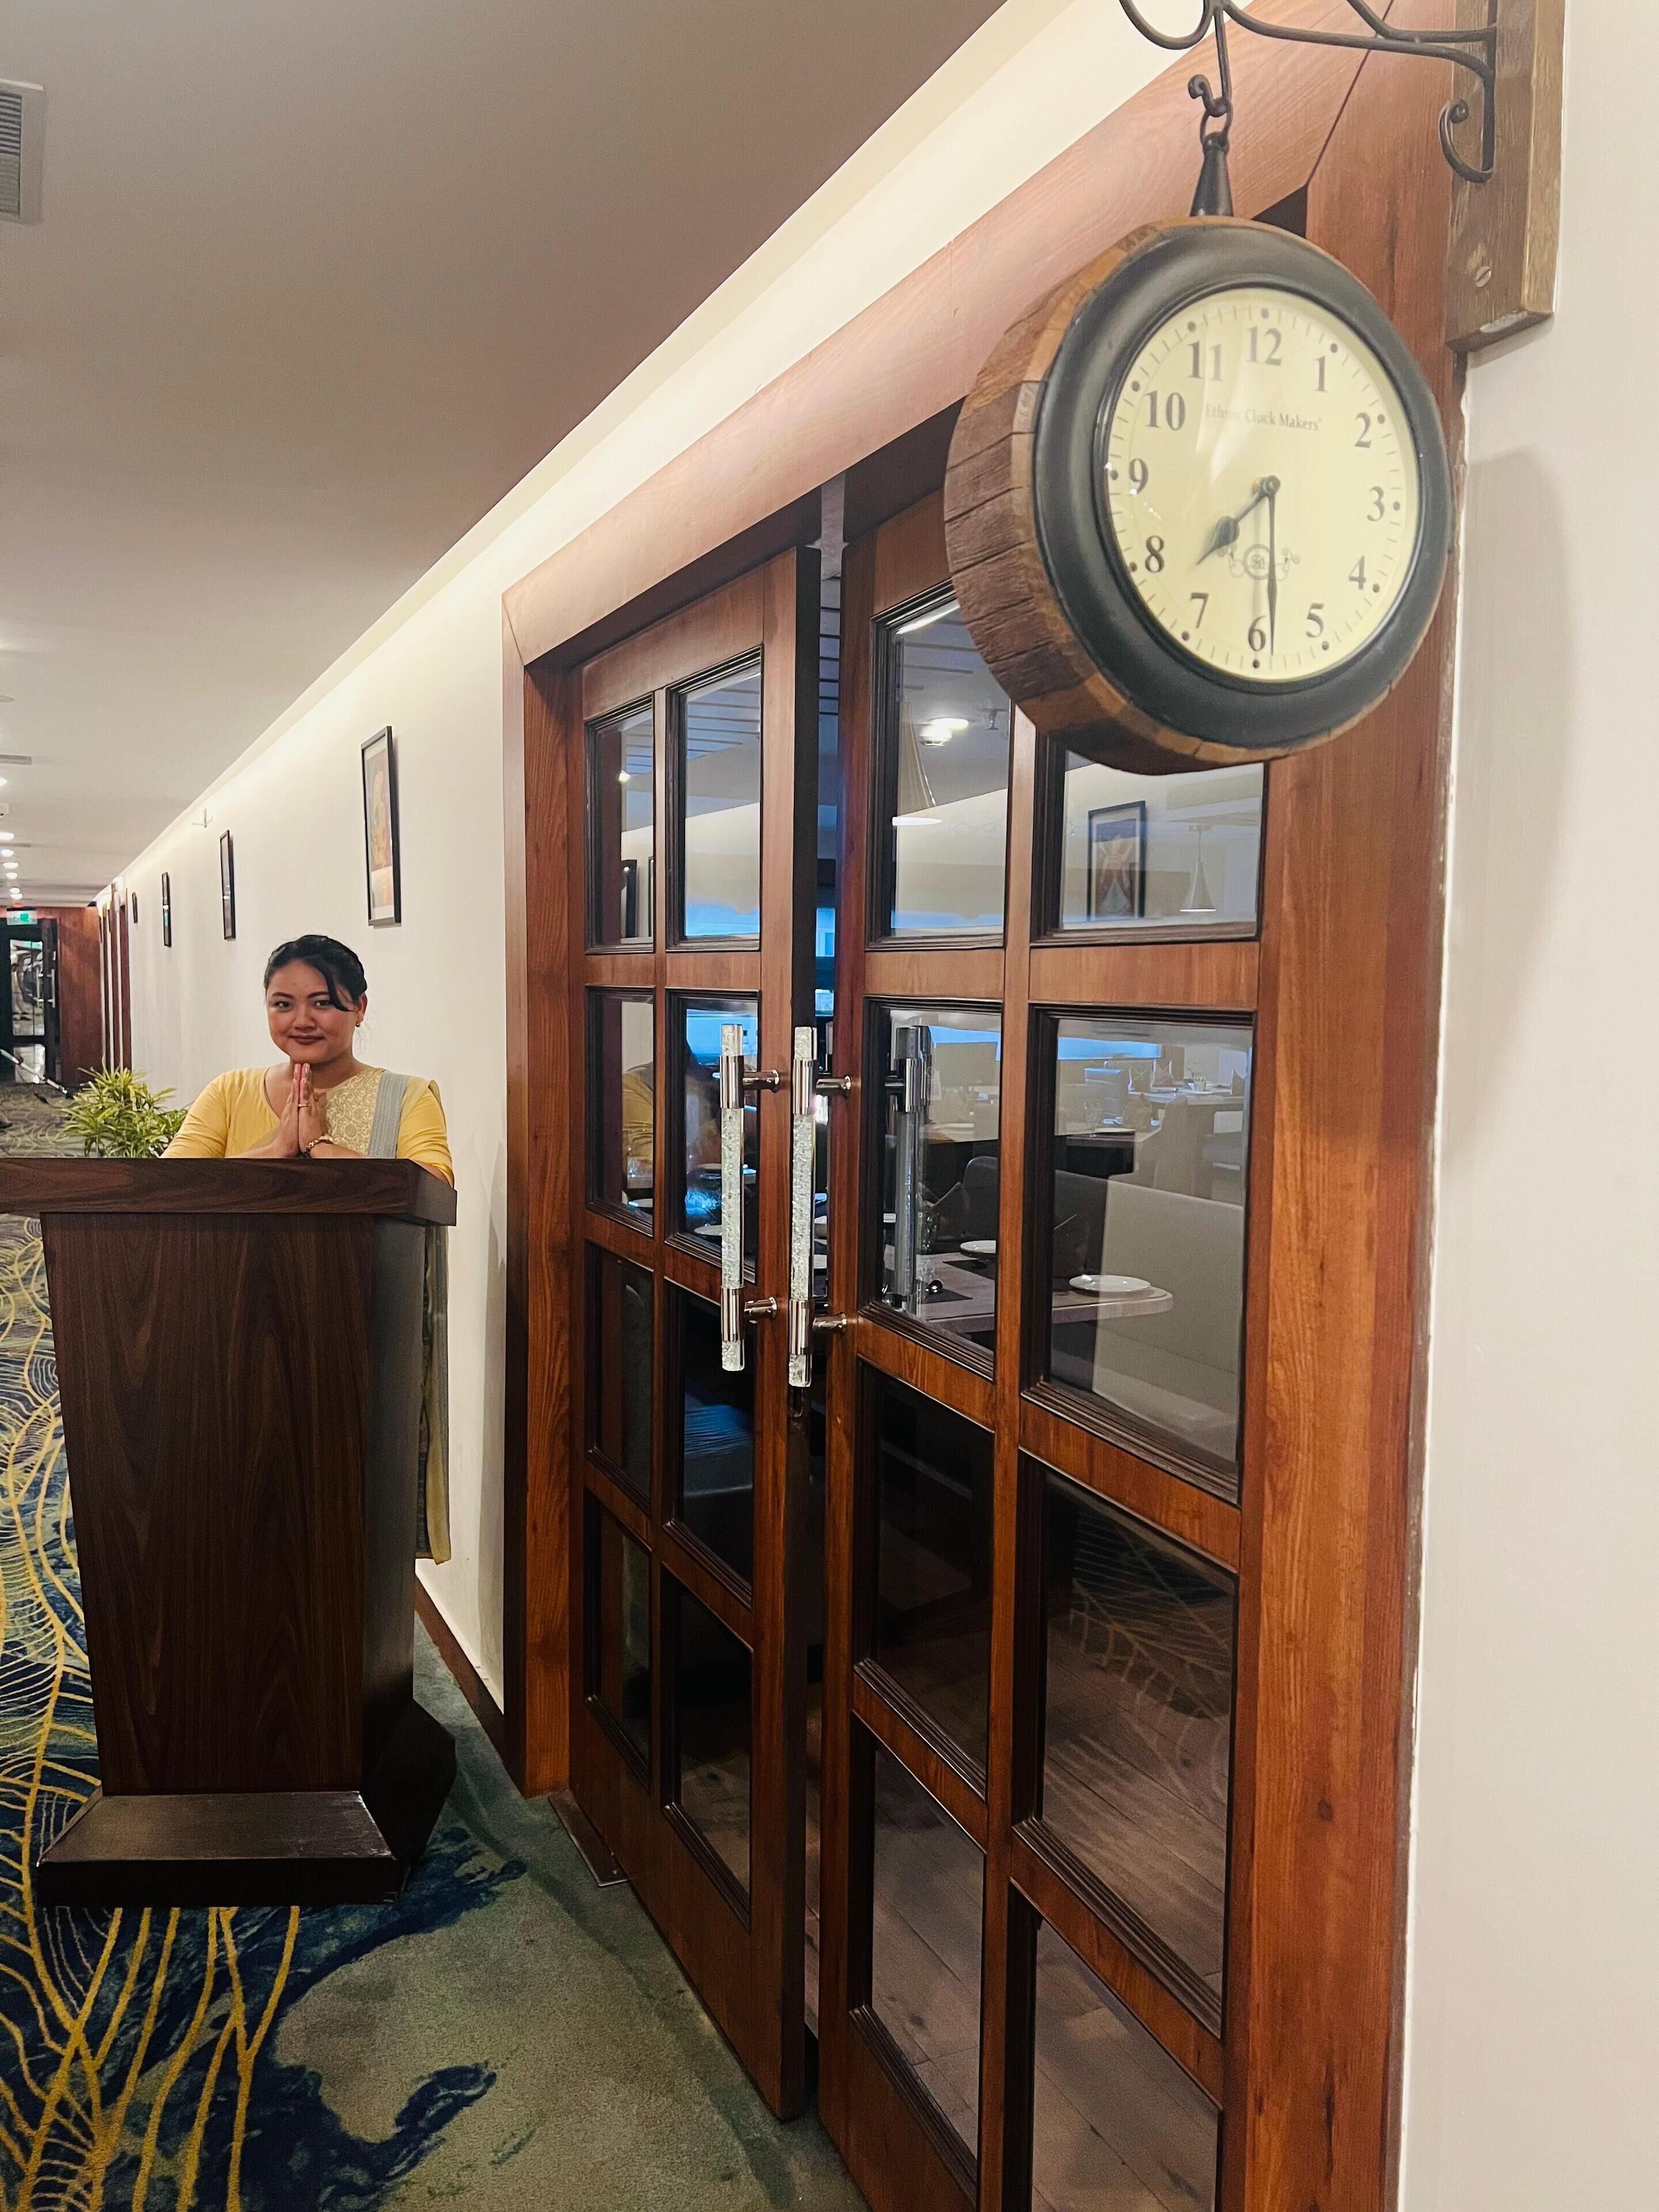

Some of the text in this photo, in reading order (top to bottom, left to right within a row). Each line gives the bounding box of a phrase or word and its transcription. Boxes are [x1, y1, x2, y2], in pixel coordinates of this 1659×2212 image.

[1188, 340, 1222, 381] 11
[1245, 327, 1282, 366] 12
[1315, 355, 1327, 392] 1
[1143, 391, 1185, 430] 10
[1245, 408, 1276, 425] Clock
[1279, 412, 1319, 431] Makers
[1355, 412, 1372, 448] 2
[1128, 459, 1149, 494] 9
[1367, 486, 1385, 521] 3
[1145, 536, 1164, 573] 8
[1349, 556, 1366, 589] 4
[1190, 593, 1209, 628] 7
[1306, 603, 1325, 638] 5
[1248, 616, 1266, 651] 6
